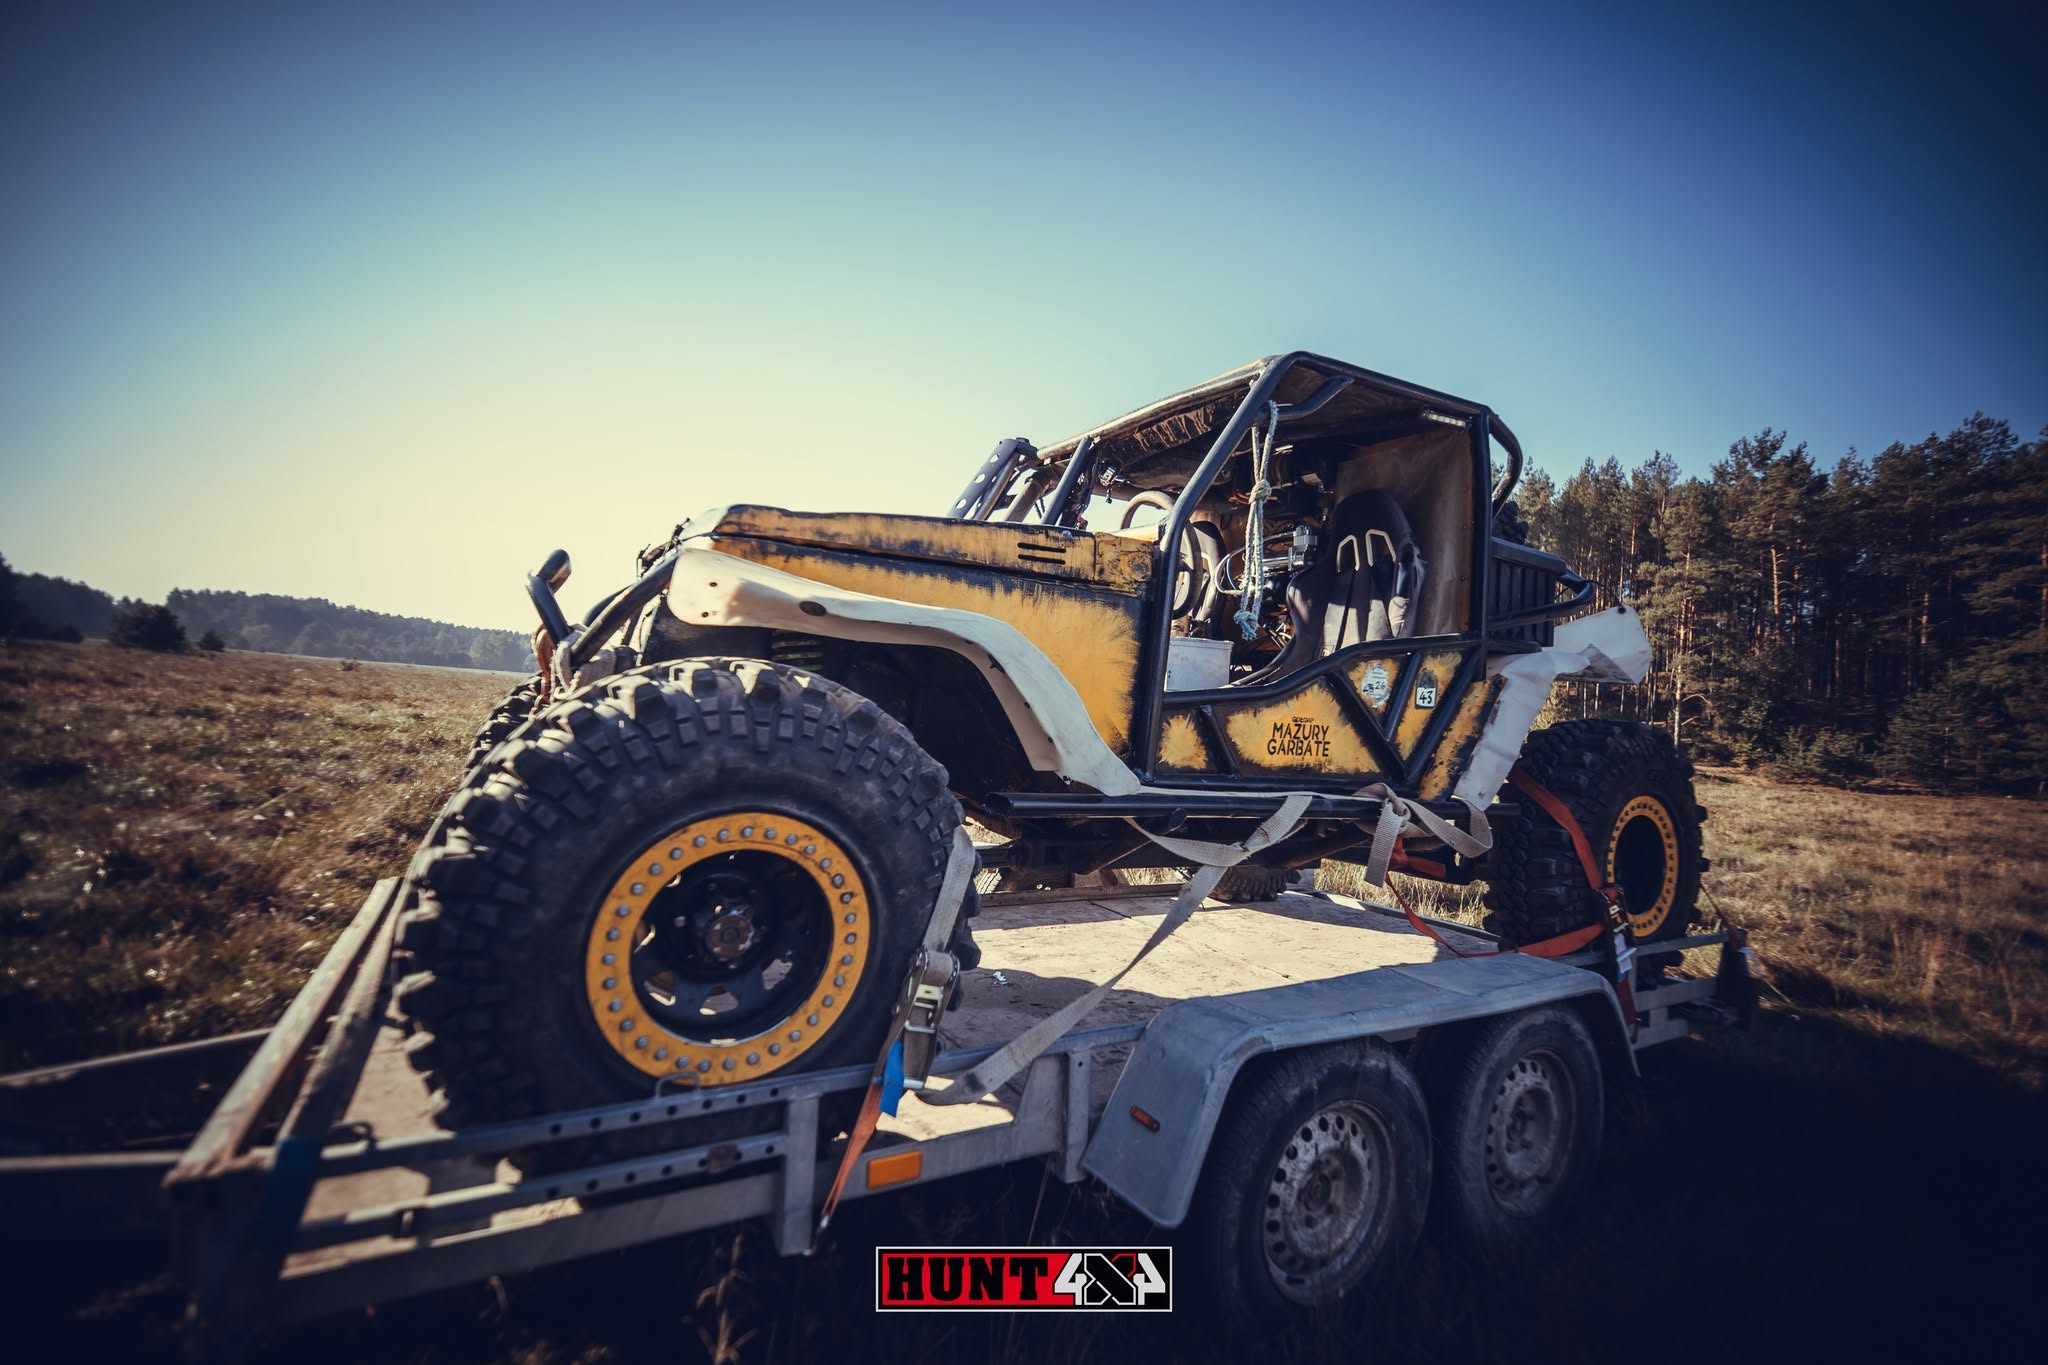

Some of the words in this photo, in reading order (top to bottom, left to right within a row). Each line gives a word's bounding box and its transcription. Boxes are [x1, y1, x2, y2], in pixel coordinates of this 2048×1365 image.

[1419, 690, 1434, 705] 43
[1272, 722, 1330, 741] MAZURY
[1267, 738, 1331, 757] GARBATE
